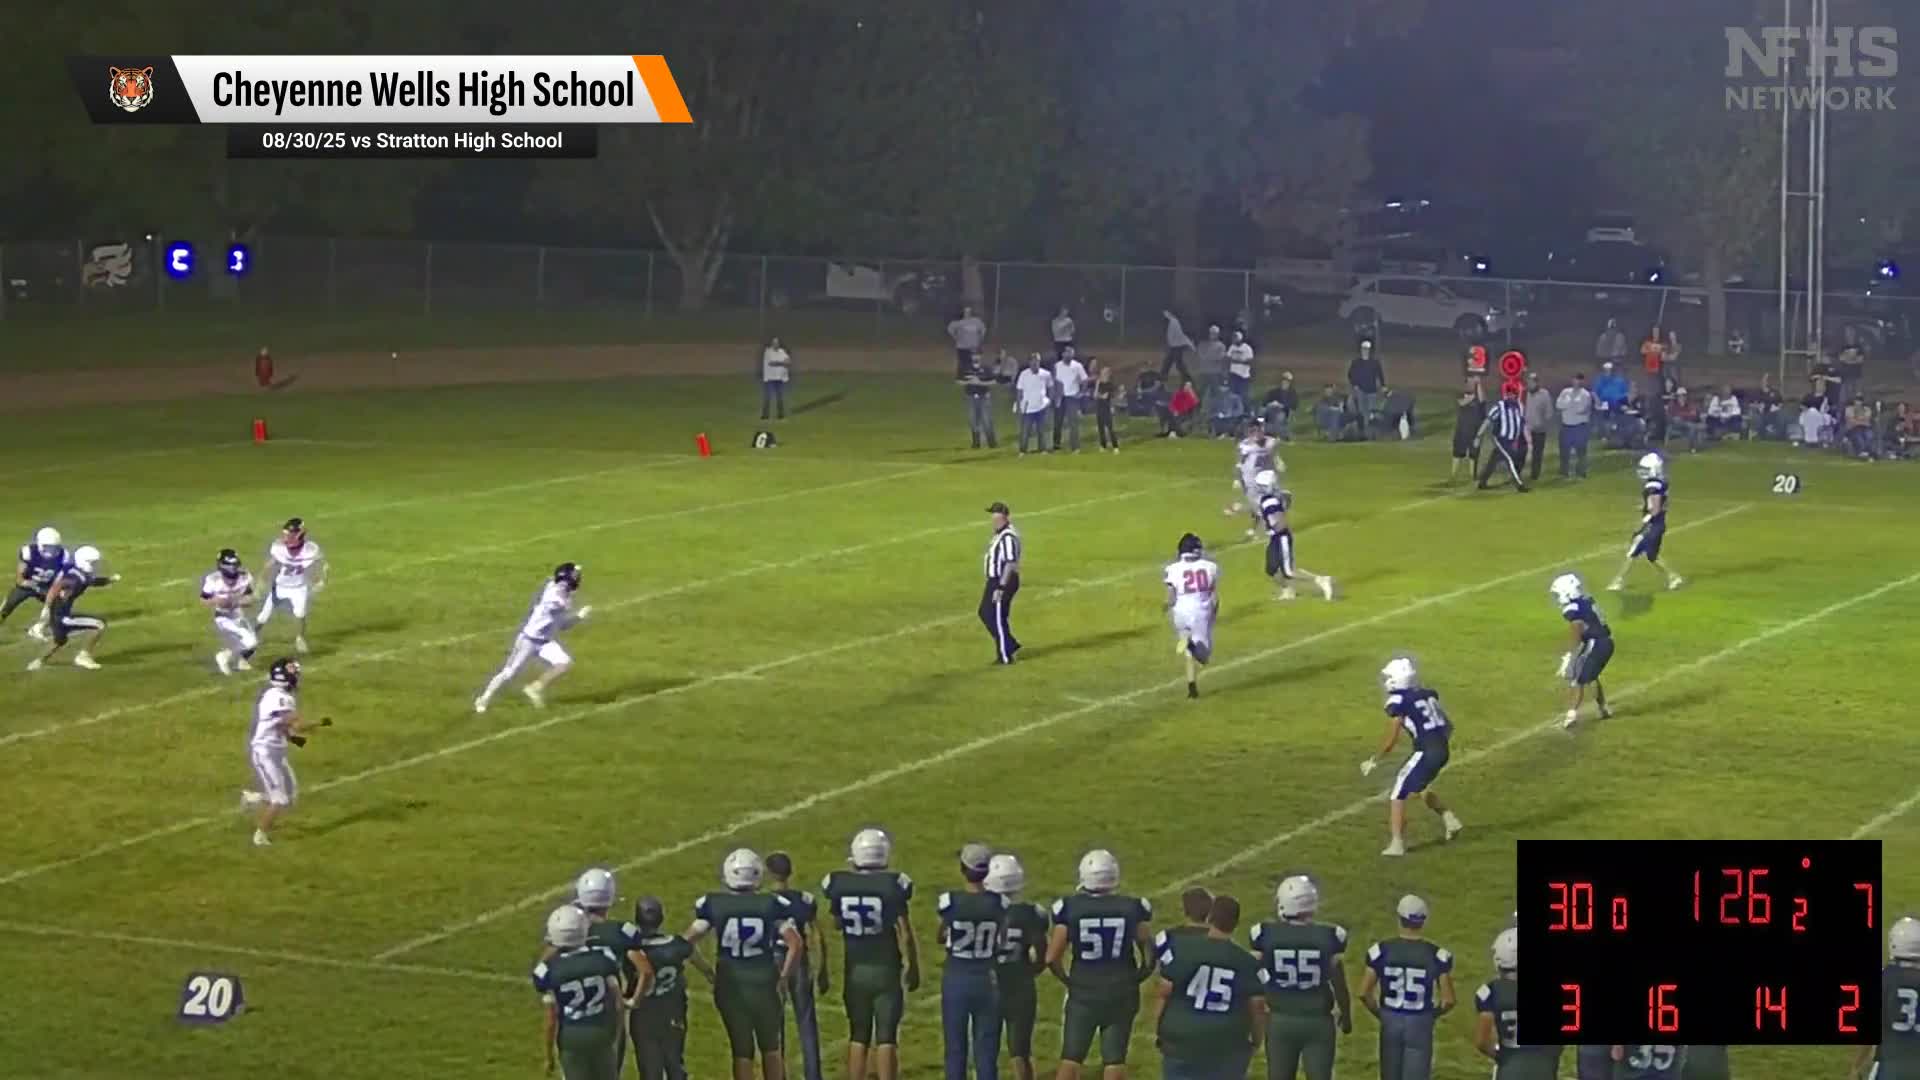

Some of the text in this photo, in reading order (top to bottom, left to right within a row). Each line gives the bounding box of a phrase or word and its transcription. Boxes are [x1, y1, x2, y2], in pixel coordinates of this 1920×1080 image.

[1772, 474, 1796, 494] 20
[1183, 569, 1209, 593] 20
[840, 896, 883, 936] 53
[721, 917, 765, 958] 42
[952, 920, 998, 959] 20
[1079, 917, 1126, 960] 57
[1186, 964, 1236, 1012] 45
[1274, 949, 1321, 990] 55
[1383, 966, 1427, 1010] 35
[183, 976, 232, 1017] 20
